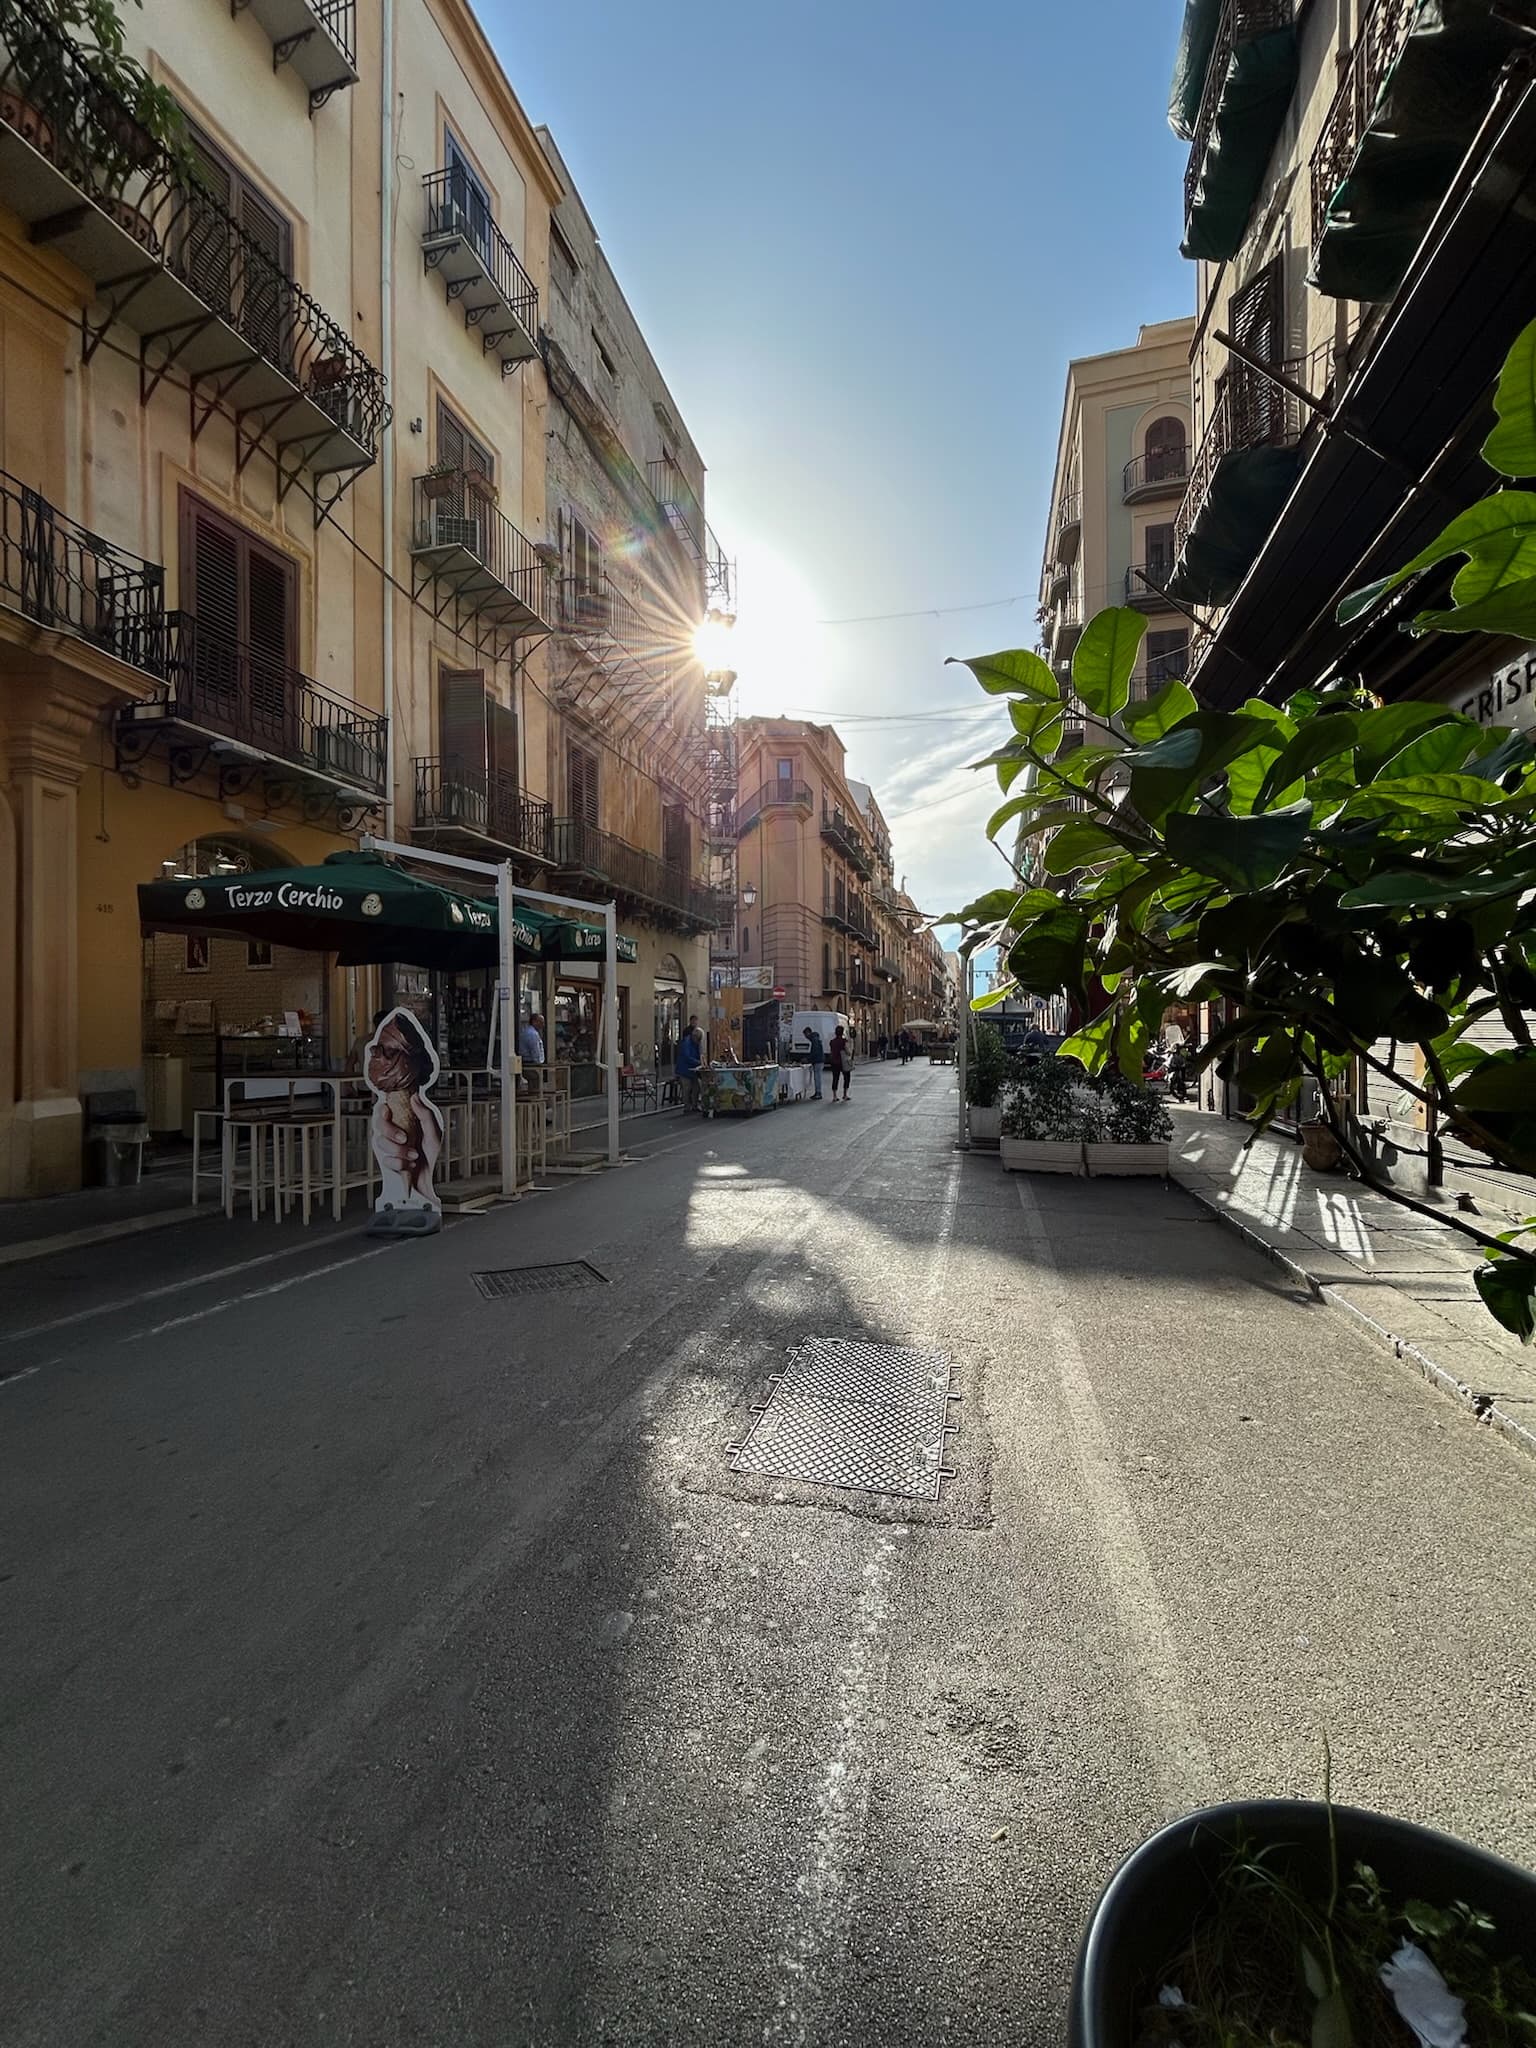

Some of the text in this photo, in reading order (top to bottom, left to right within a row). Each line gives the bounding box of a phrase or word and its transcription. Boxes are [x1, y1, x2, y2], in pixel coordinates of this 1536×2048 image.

[224, 882, 344, 910] Terzo Cerchio
[463, 903, 534, 946] Terzo erchio
